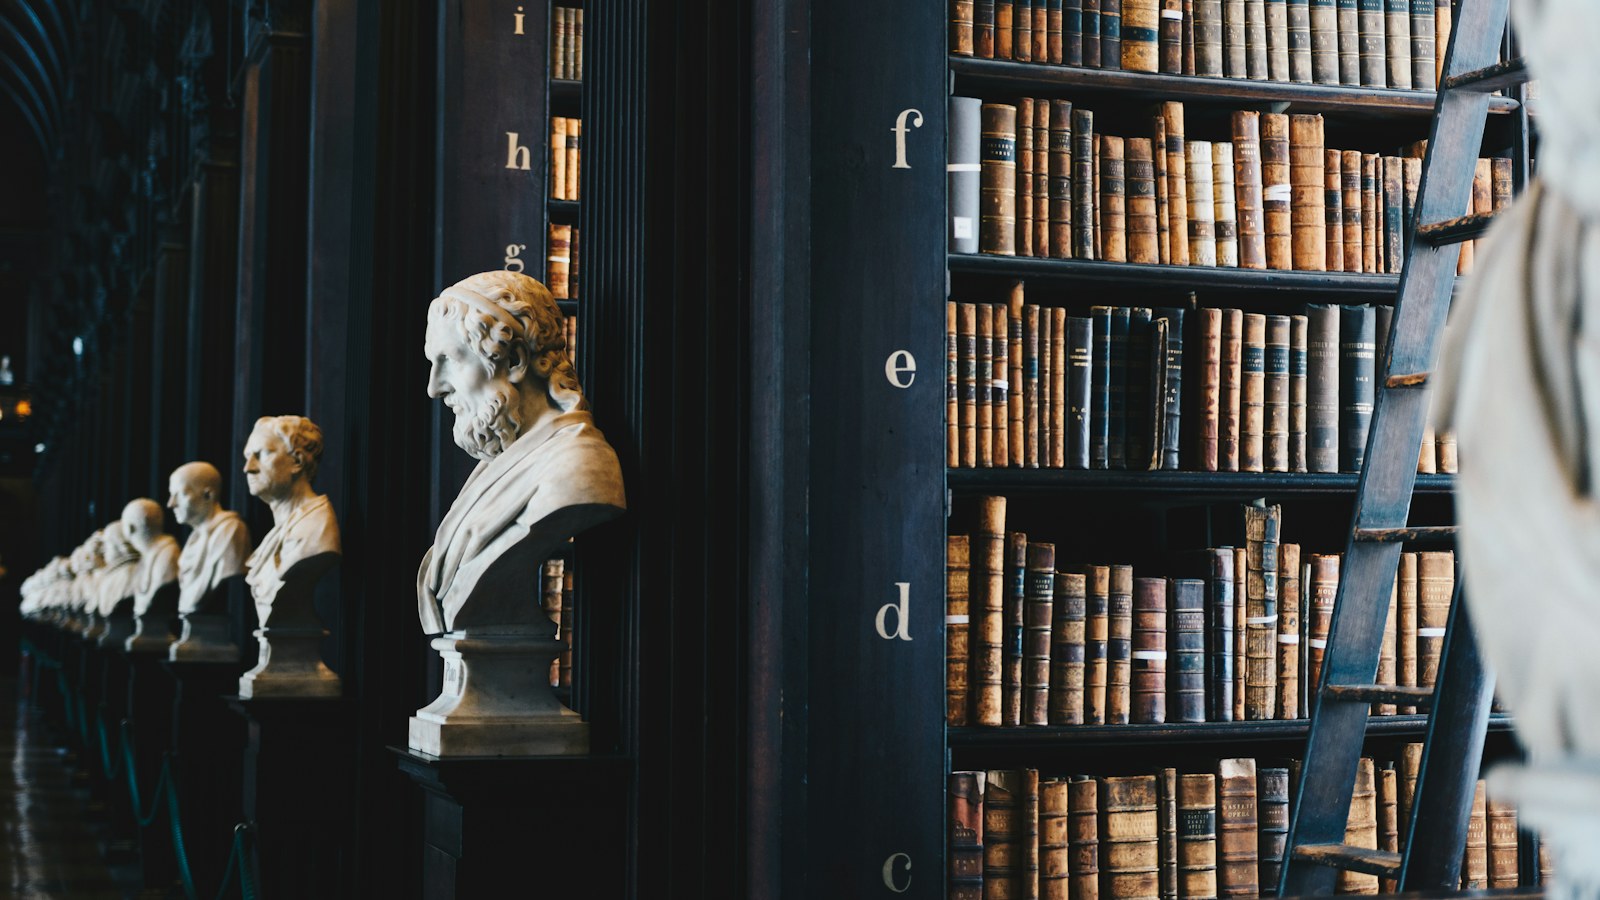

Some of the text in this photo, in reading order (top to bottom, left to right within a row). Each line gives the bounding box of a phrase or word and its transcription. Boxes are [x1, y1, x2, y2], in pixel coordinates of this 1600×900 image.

[513, 6, 525, 35] i
[505, 132, 531, 170] h
[890, 108, 923, 168] f
[504, 244, 526, 273] g
[885, 349, 917, 389] e
[875, 582, 913, 641] d
[882, 852, 912, 893] c
